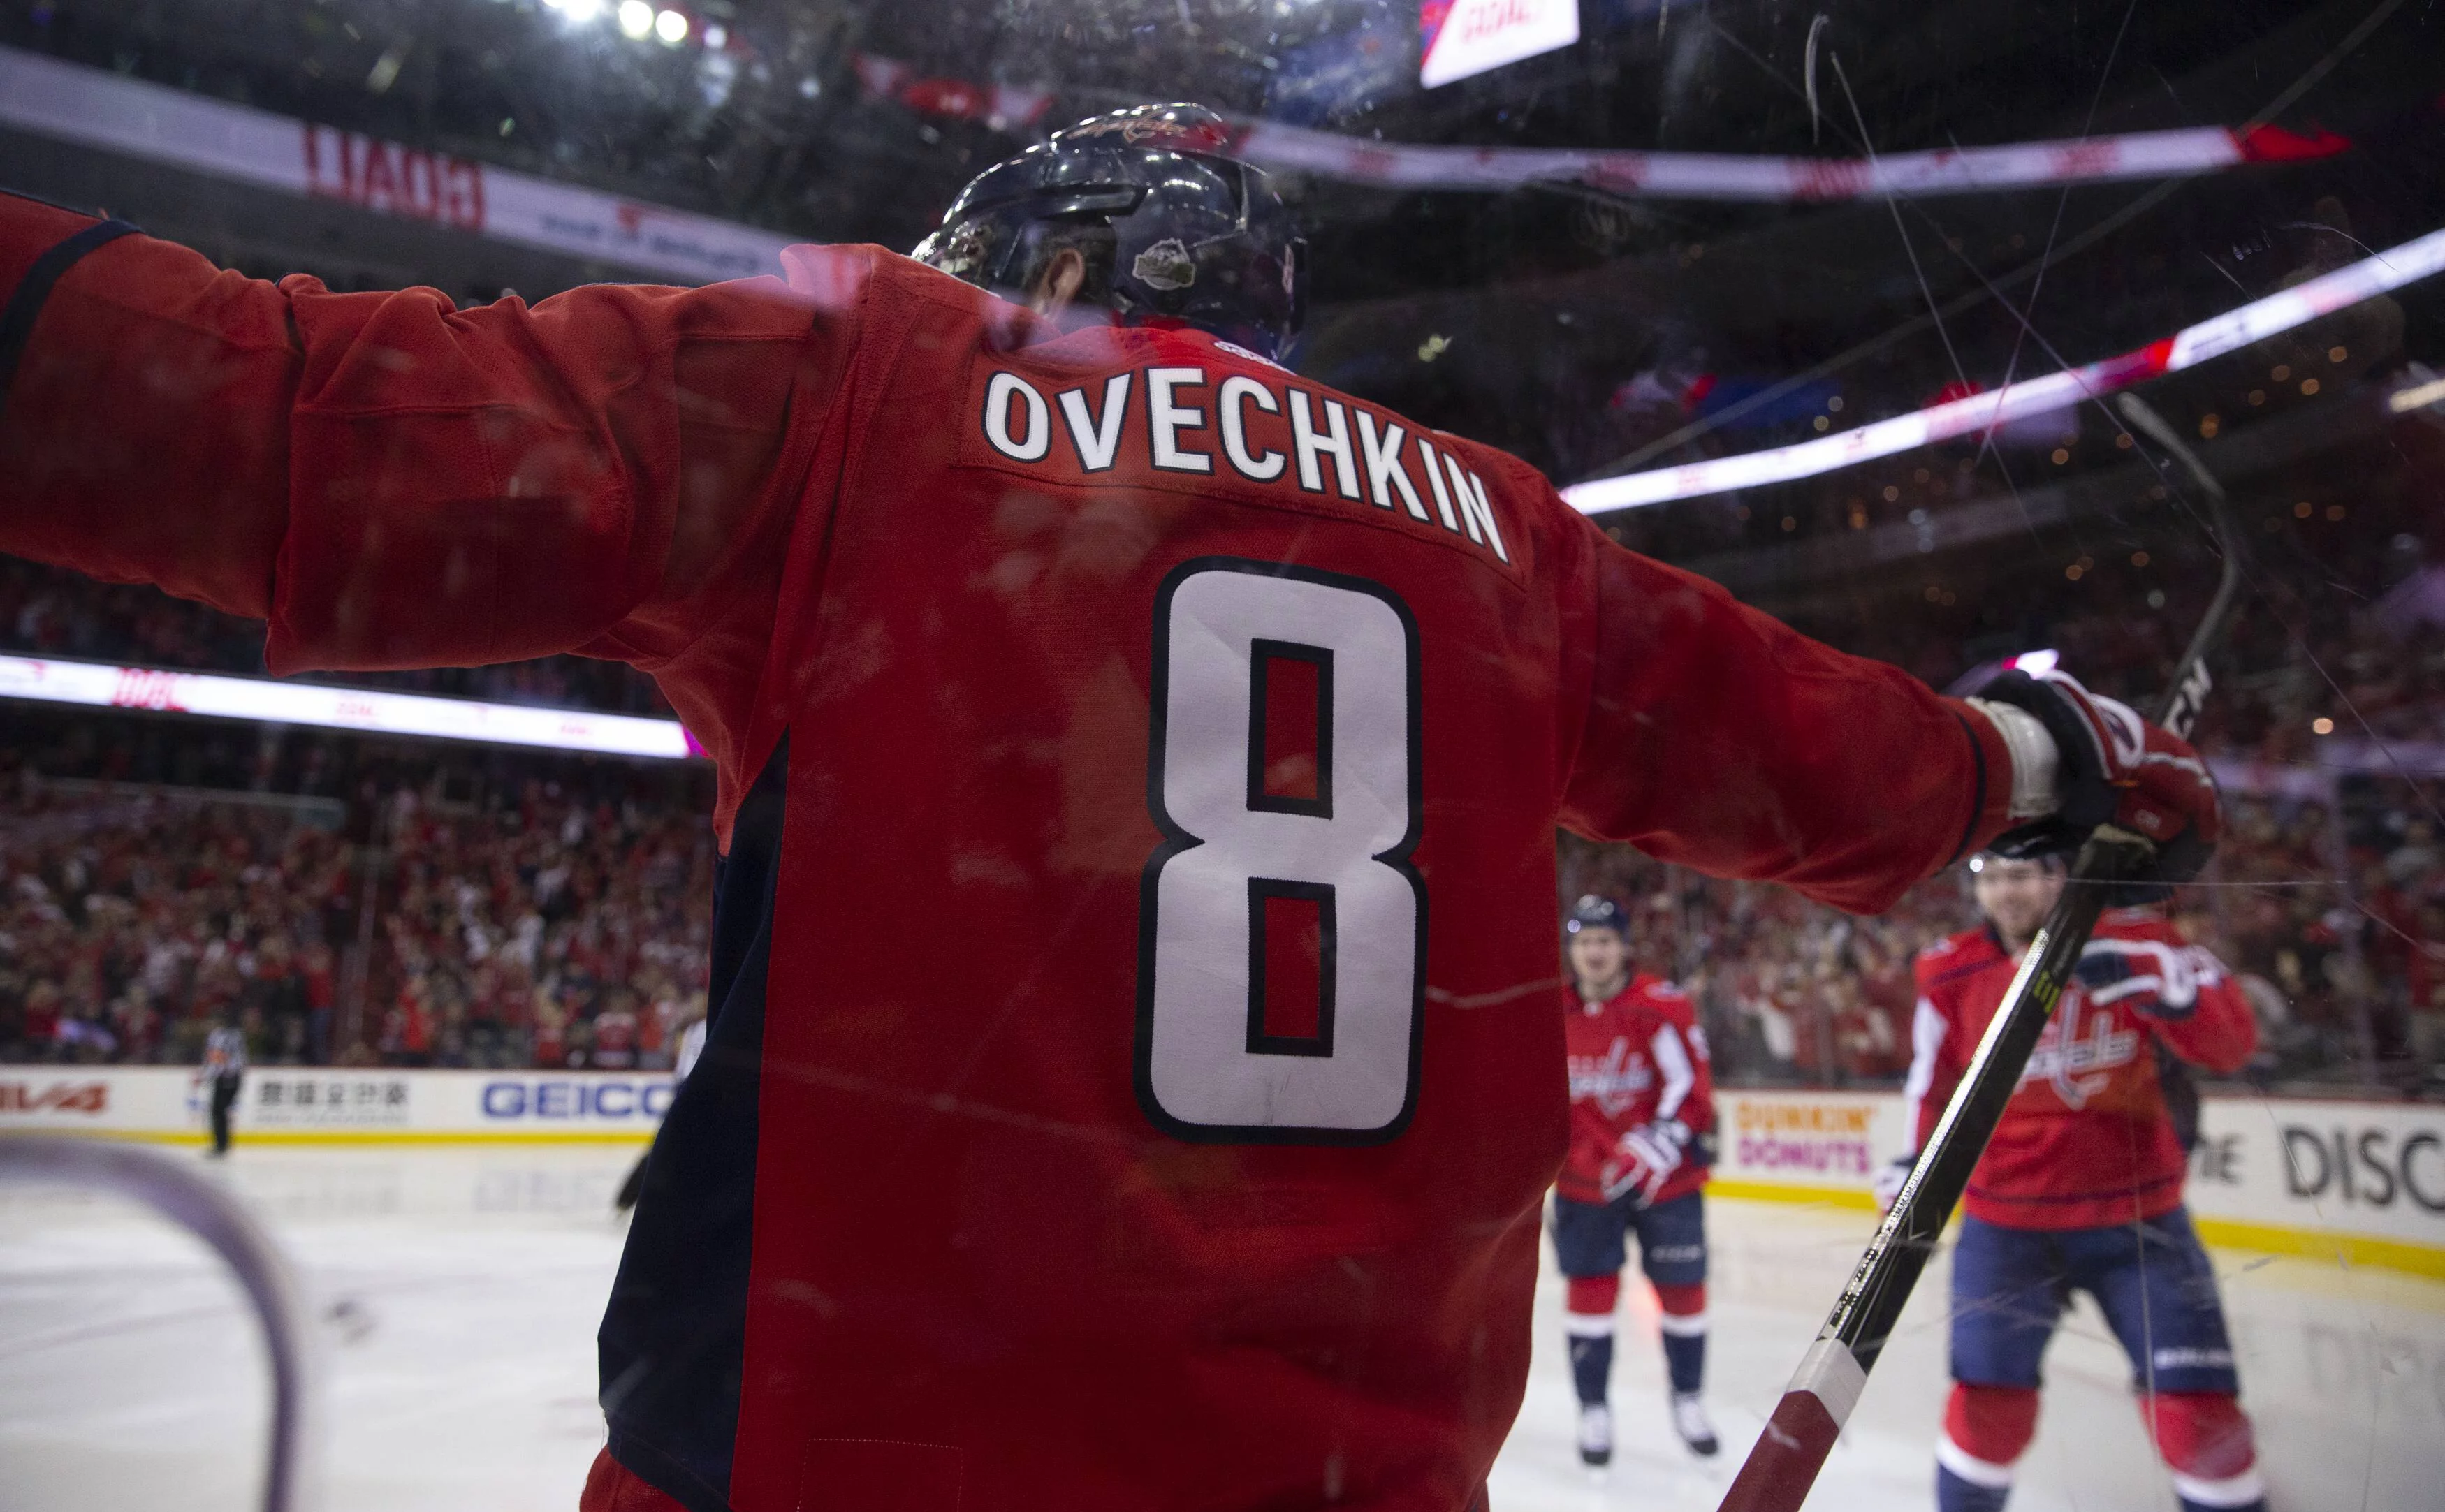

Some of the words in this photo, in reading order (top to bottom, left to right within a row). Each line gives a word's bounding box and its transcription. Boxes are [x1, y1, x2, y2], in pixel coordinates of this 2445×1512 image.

[981, 366, 1510, 564] OVECHKIN
[1132, 555, 1429, 1146] 8
[1737, 1136, 1872, 1174] DONUTS
[2279, 1122, 2445, 1212] DISC
